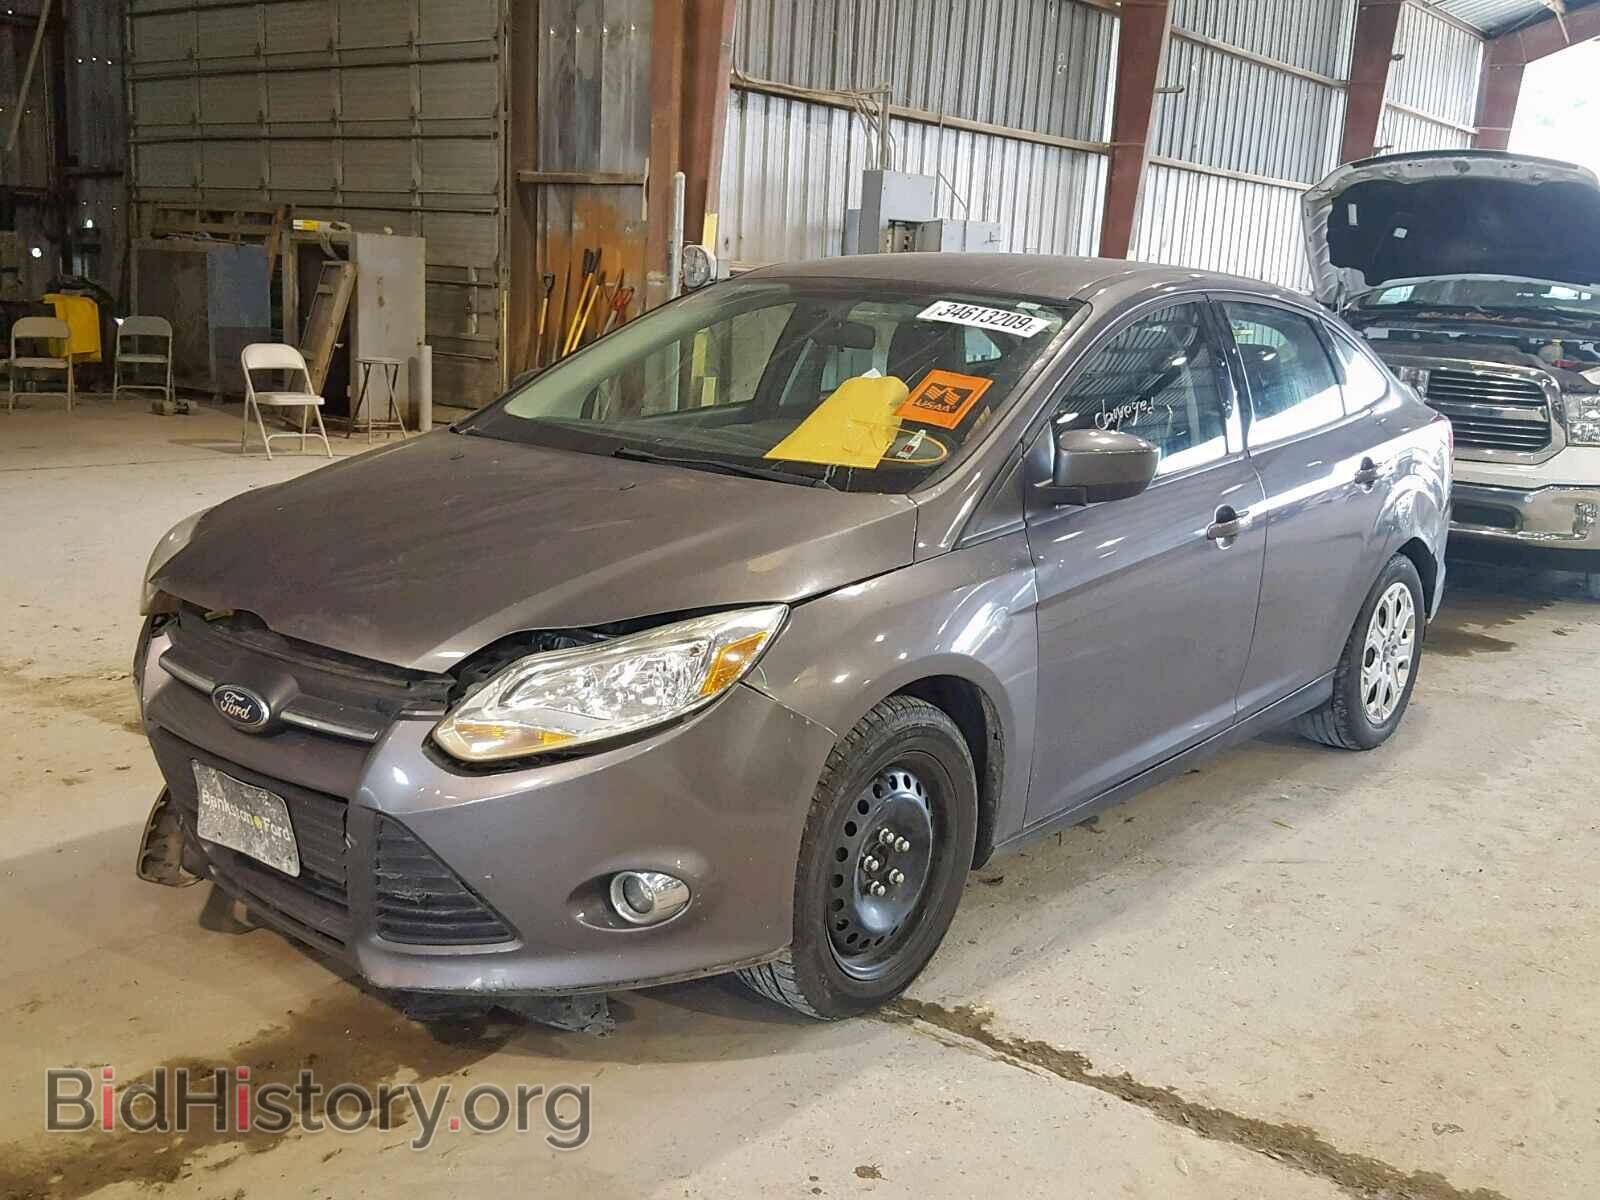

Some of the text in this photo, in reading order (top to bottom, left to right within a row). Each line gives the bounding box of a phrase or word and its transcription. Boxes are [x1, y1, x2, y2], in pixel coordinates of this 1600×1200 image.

[938, 304, 1032, 329] 34613209
[916, 398, 953, 413] USAA
[220, 691, 252, 720] Ford
[262, 816, 291, 841] Ford
